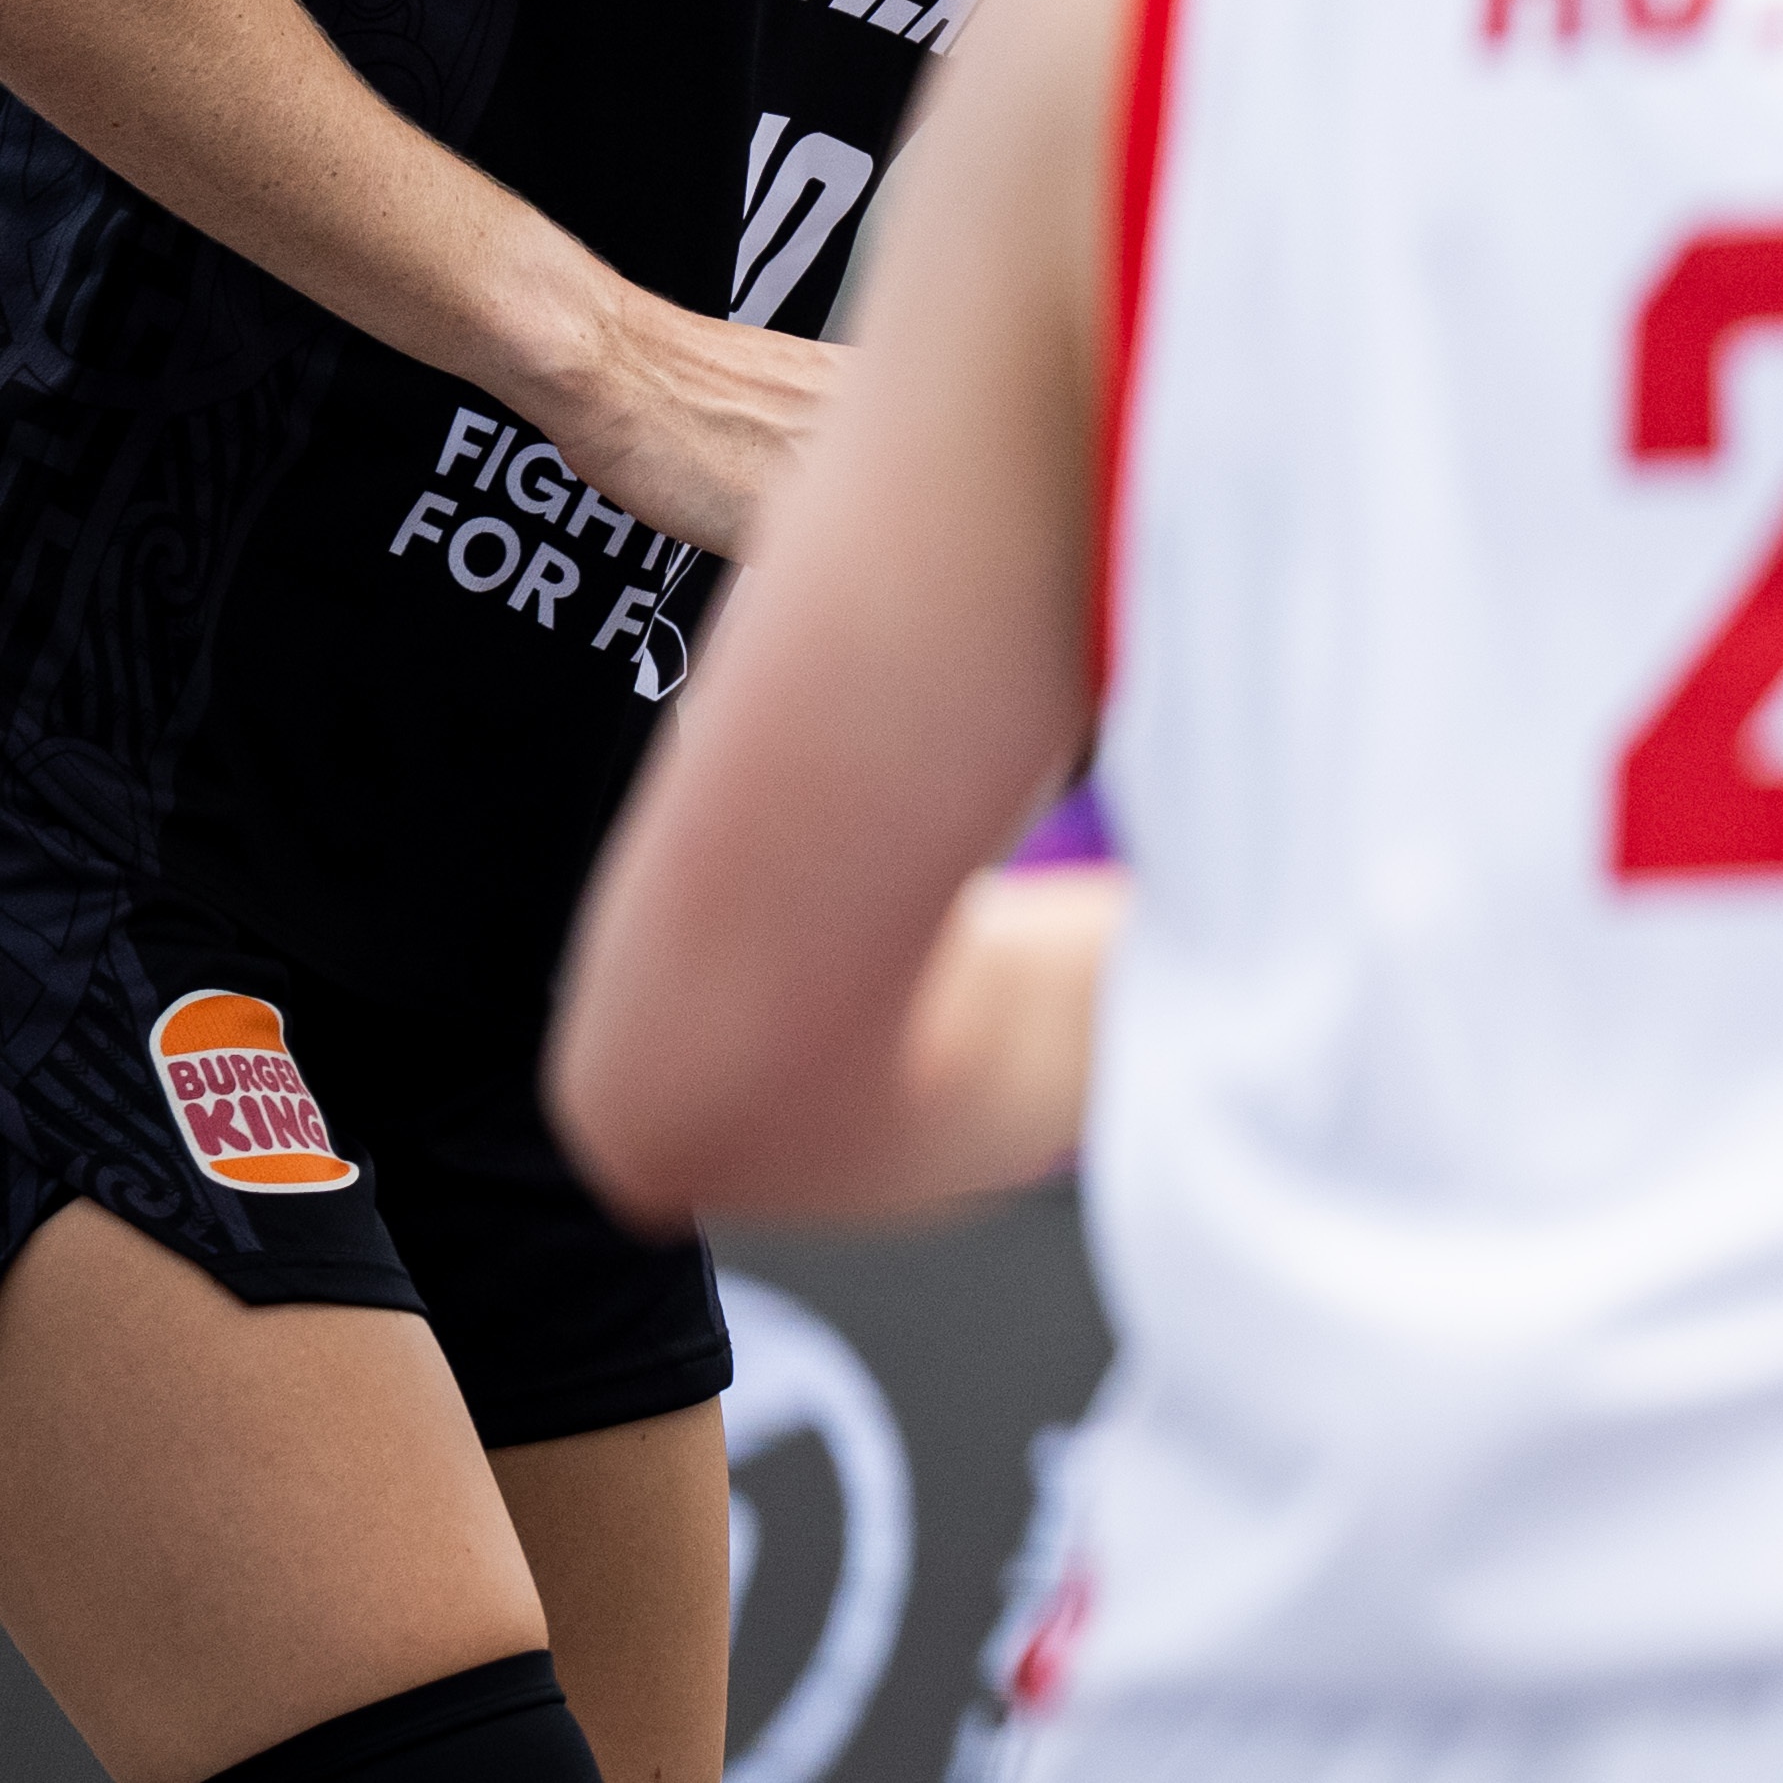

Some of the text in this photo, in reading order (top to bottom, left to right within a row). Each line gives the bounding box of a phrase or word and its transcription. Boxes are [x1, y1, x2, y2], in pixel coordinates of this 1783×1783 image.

[388, 491, 658, 663] FOR F
[167, 1054, 311, 1102] BURGER
[183, 1094, 330, 1157] KING
